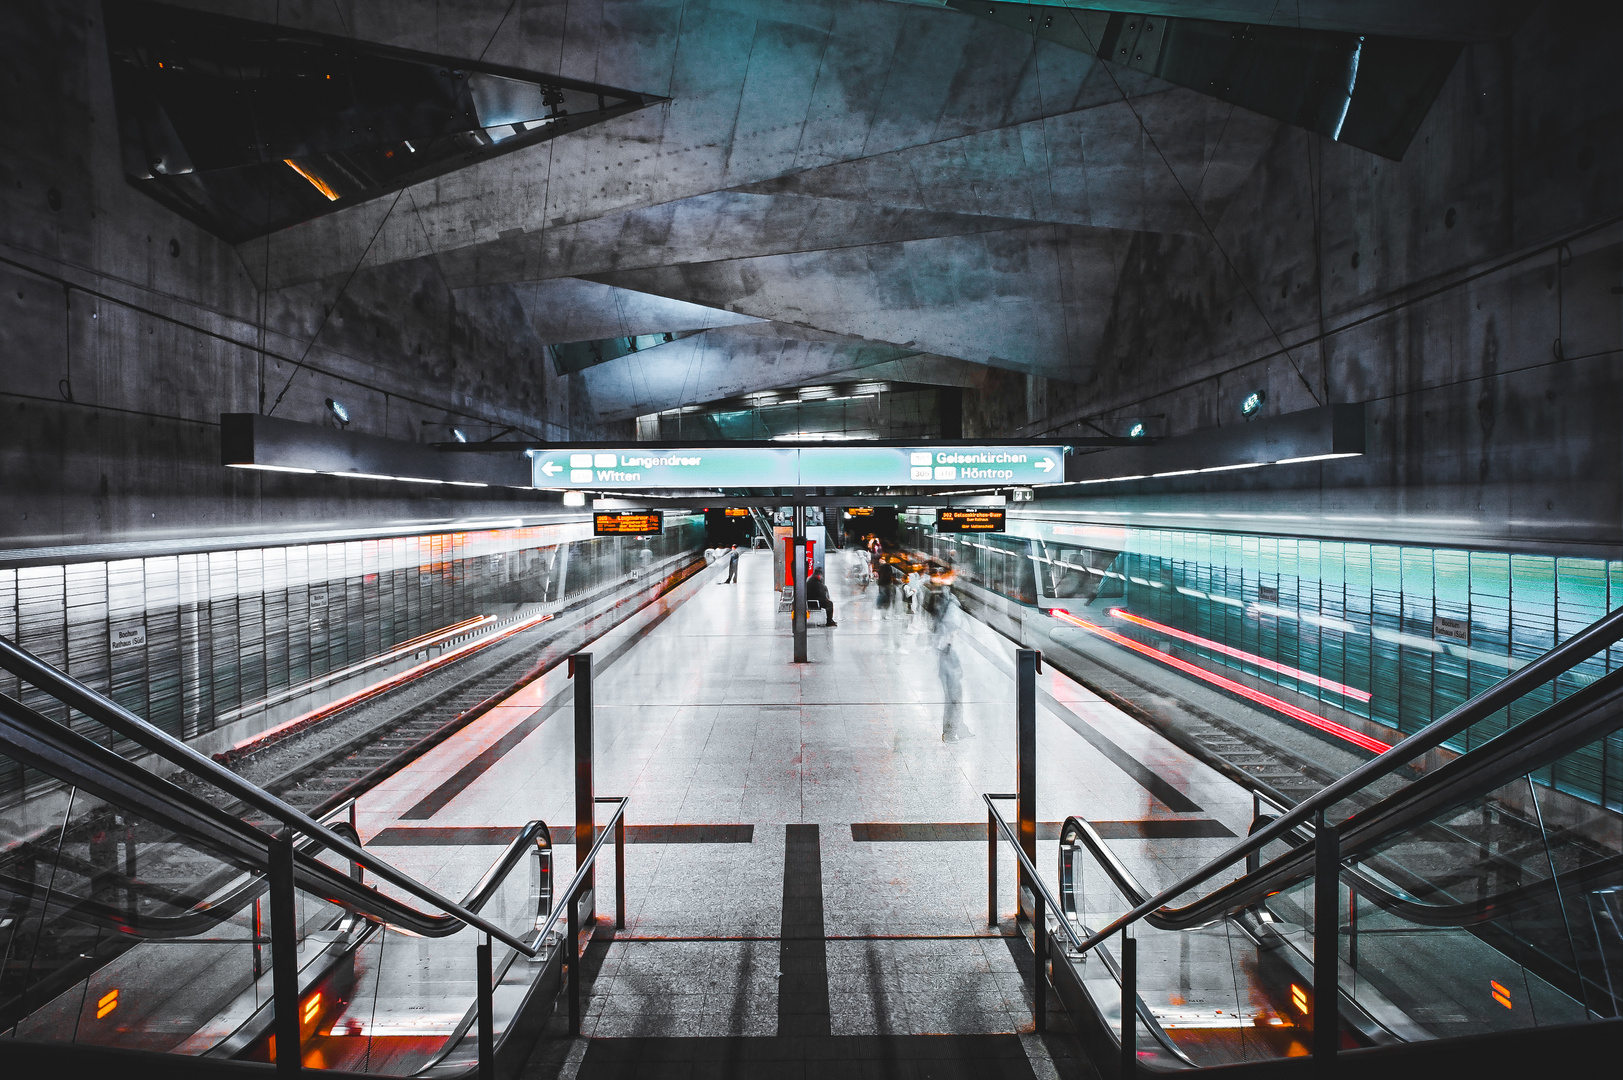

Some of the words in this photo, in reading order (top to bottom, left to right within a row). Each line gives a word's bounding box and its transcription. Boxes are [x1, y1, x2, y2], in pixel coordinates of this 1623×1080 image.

[621, 455, 701, 468] Langendreer
[936, 452, 1027, 464] Gelsenkirchen
[597, 470, 641, 482] Witten
[961, 467, 1013, 480] Höntrop
[1442, 619, 1460, 628] Bochum
[118, 630, 138, 639] Bochum
[1435, 626, 1453, 636] Rathaus
[112, 640, 131, 649] Rathaus
